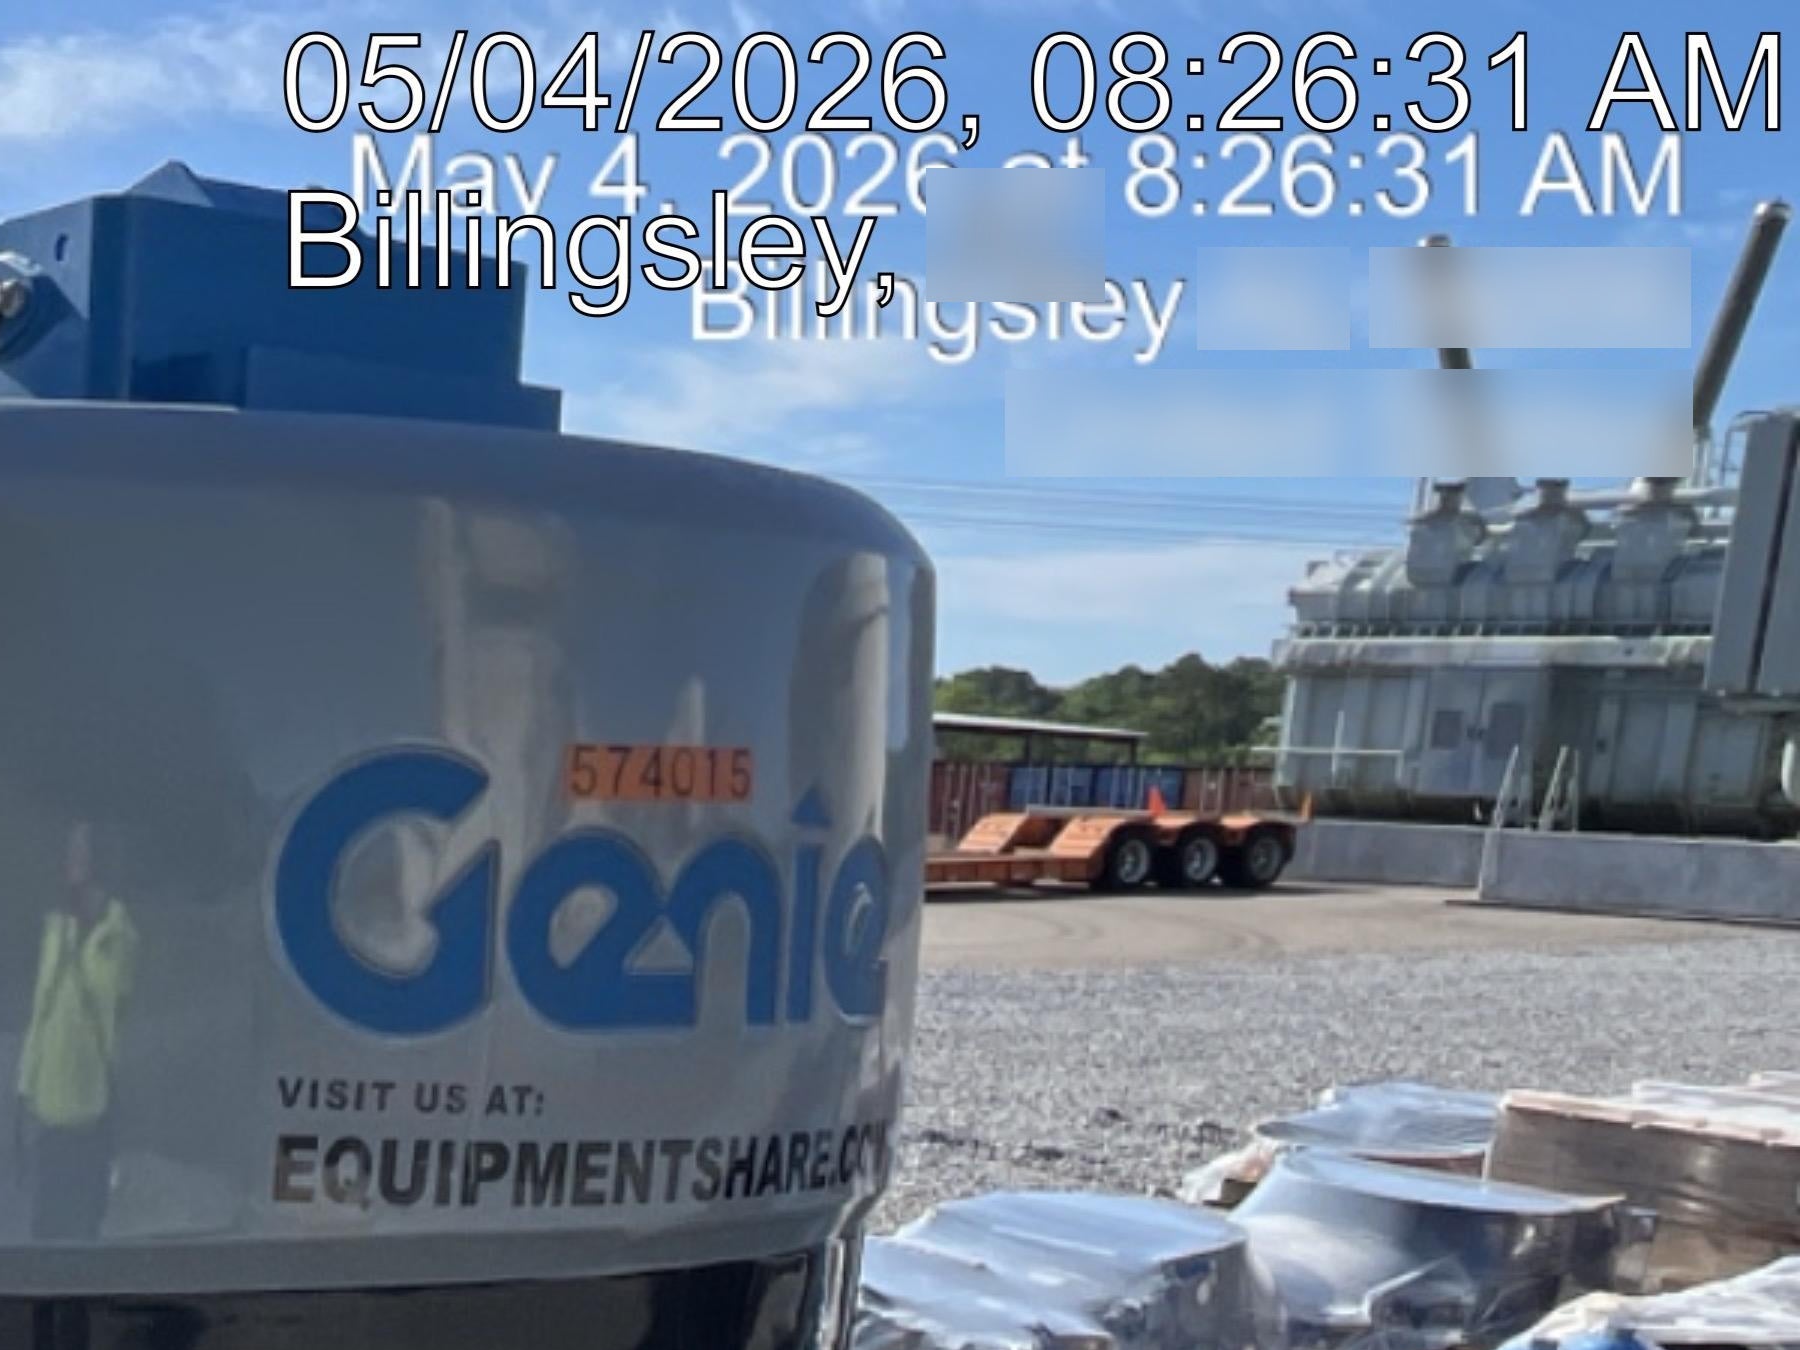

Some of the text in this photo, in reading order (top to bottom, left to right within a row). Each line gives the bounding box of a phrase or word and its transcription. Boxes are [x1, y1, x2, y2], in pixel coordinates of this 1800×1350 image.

[571, 744, 753, 799] 574015
[274, 742, 891, 1037] Genie
[278, 1076, 544, 1116] VISIT US AT:
